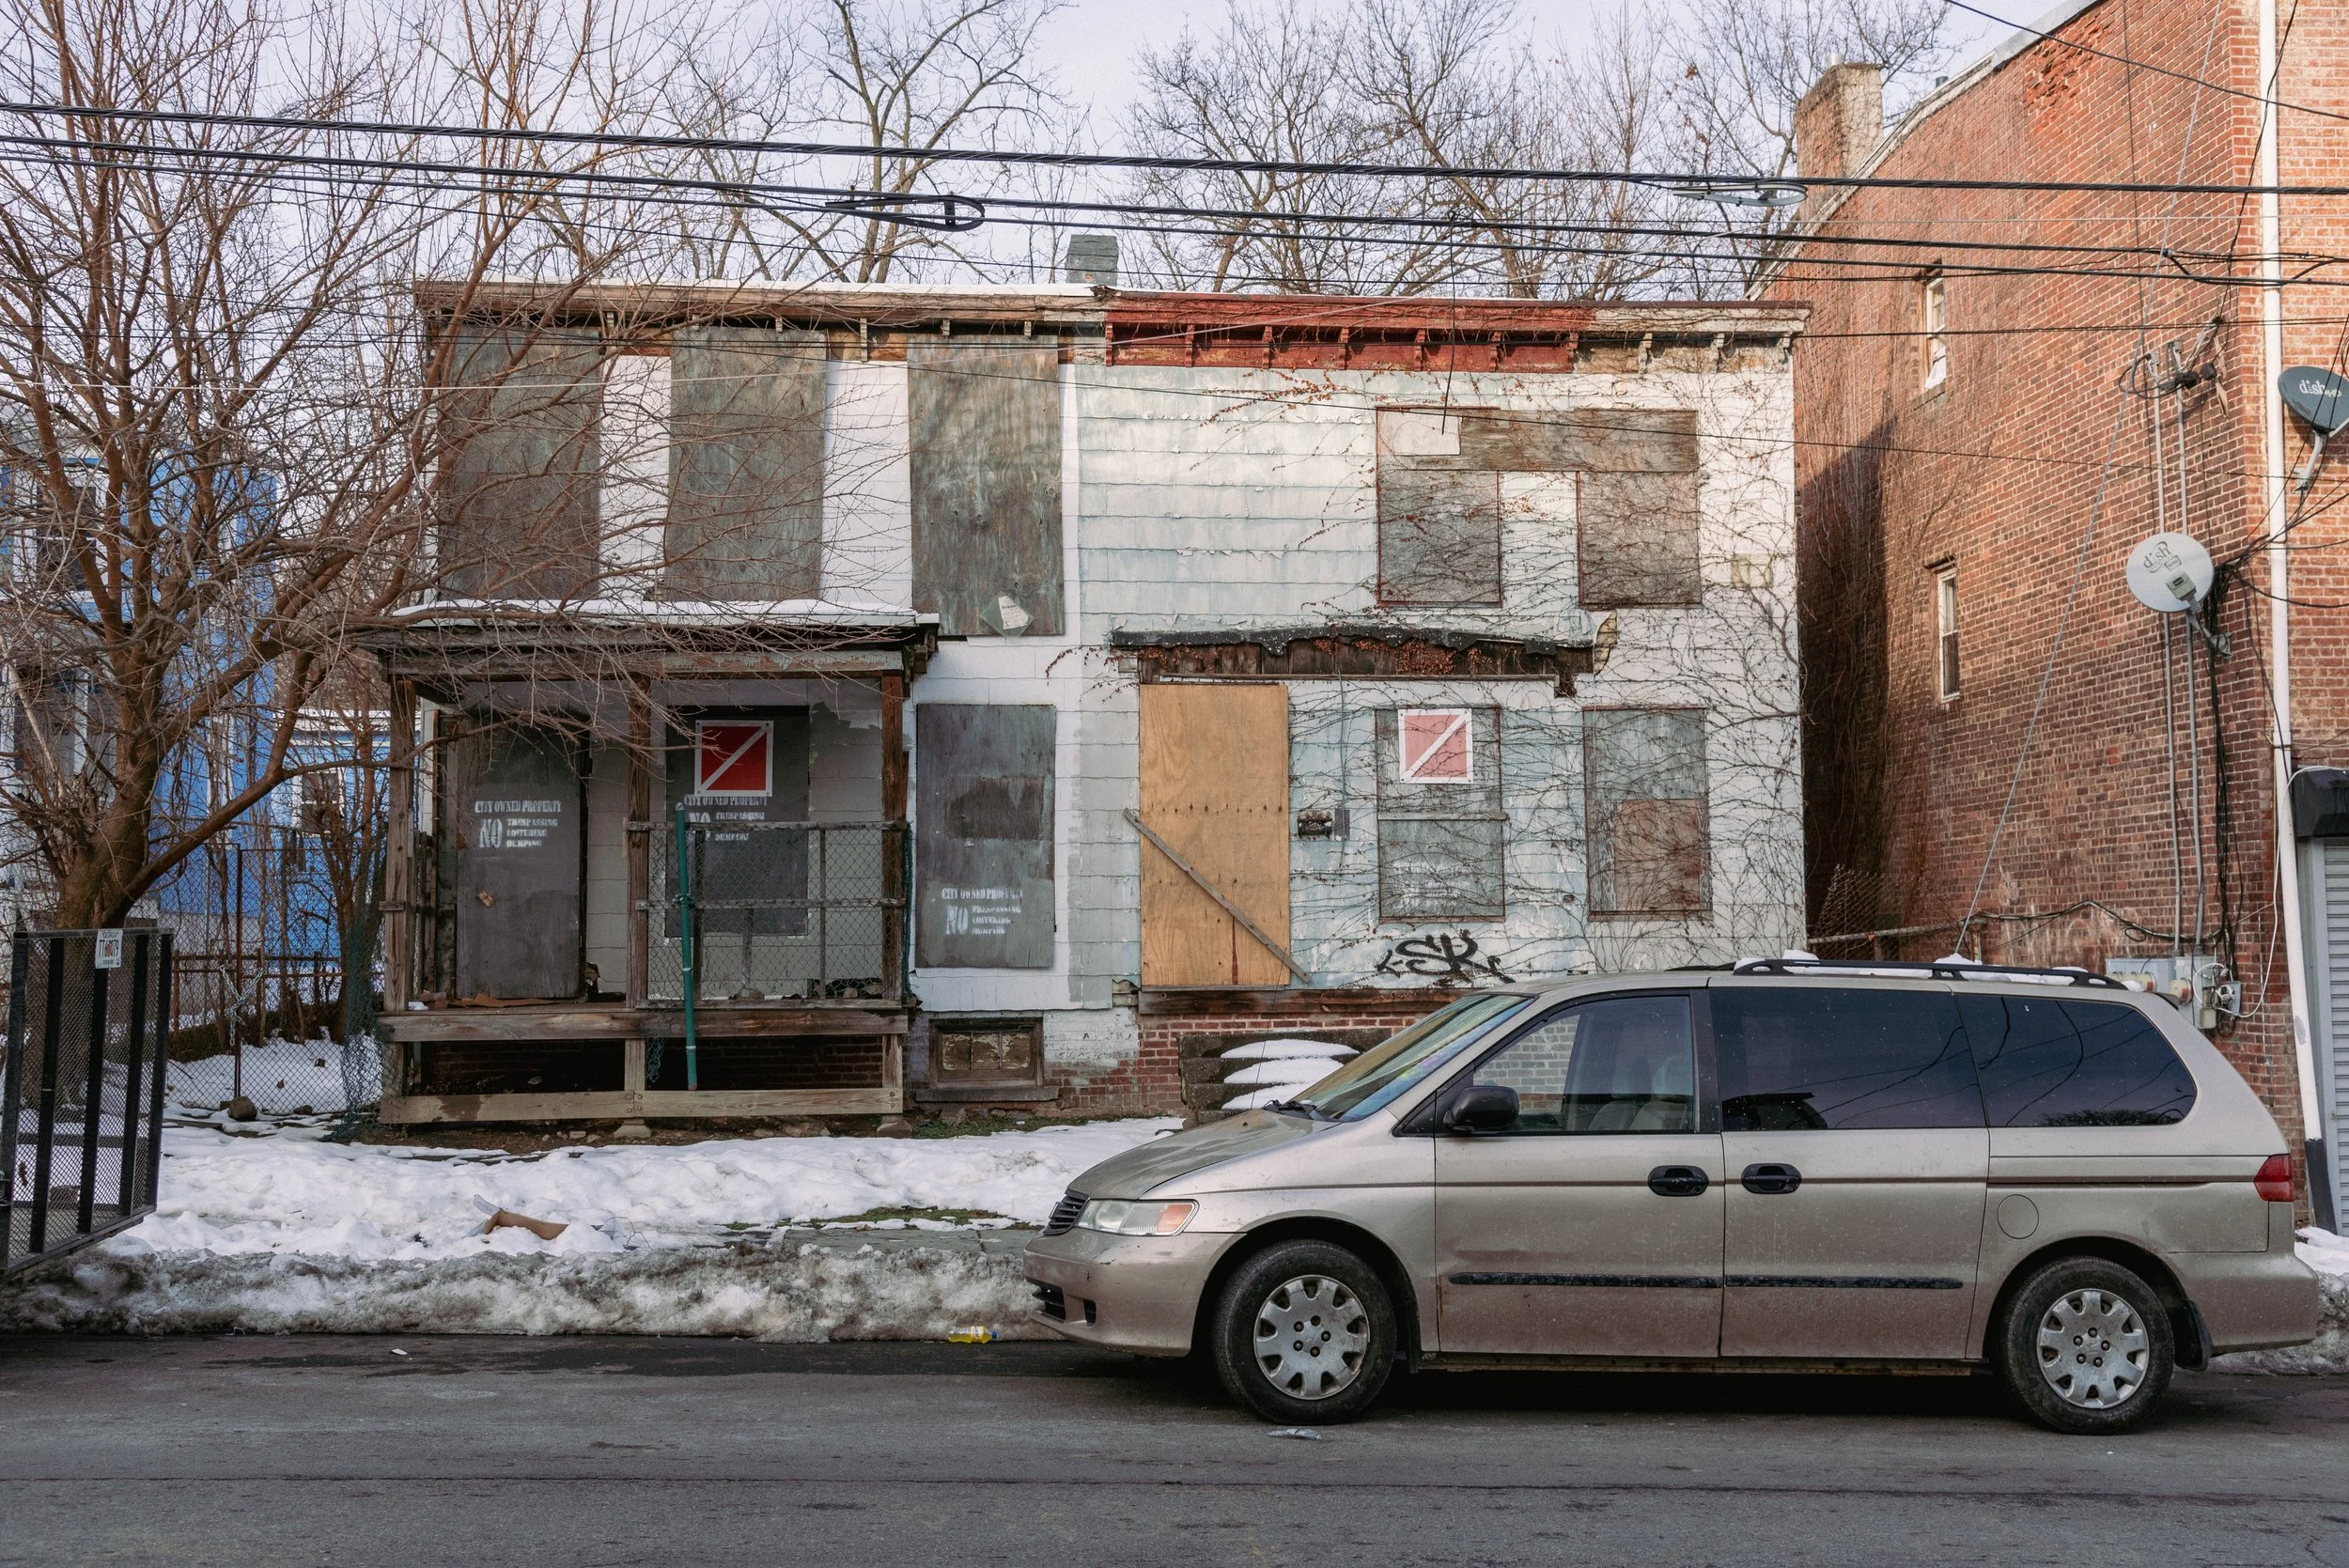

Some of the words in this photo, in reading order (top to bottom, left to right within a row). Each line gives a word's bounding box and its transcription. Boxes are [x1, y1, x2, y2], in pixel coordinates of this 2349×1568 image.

[2299, 380, 2327, 395] dish
[2143, 546, 2171, 569] dish
[684, 795, 701, 806] CITY
[703, 796, 728, 806] OWNED
[730, 796, 768, 806] PROPERTY
[474, 800, 493, 813] CITY
[494, 800, 521, 813] OWNED
[521, 800, 562, 813] PROPERTY
[716, 812, 765, 820] TRESPASSING
[506, 818, 558, 827] TRESPASSING
[479, 818, 503, 848] NO
[506, 829, 548, 837] LOITERING
[715, 833, 749, 842] DUMPING
[941, 888, 958, 899] CITY
[945, 905, 969, 935] NO
